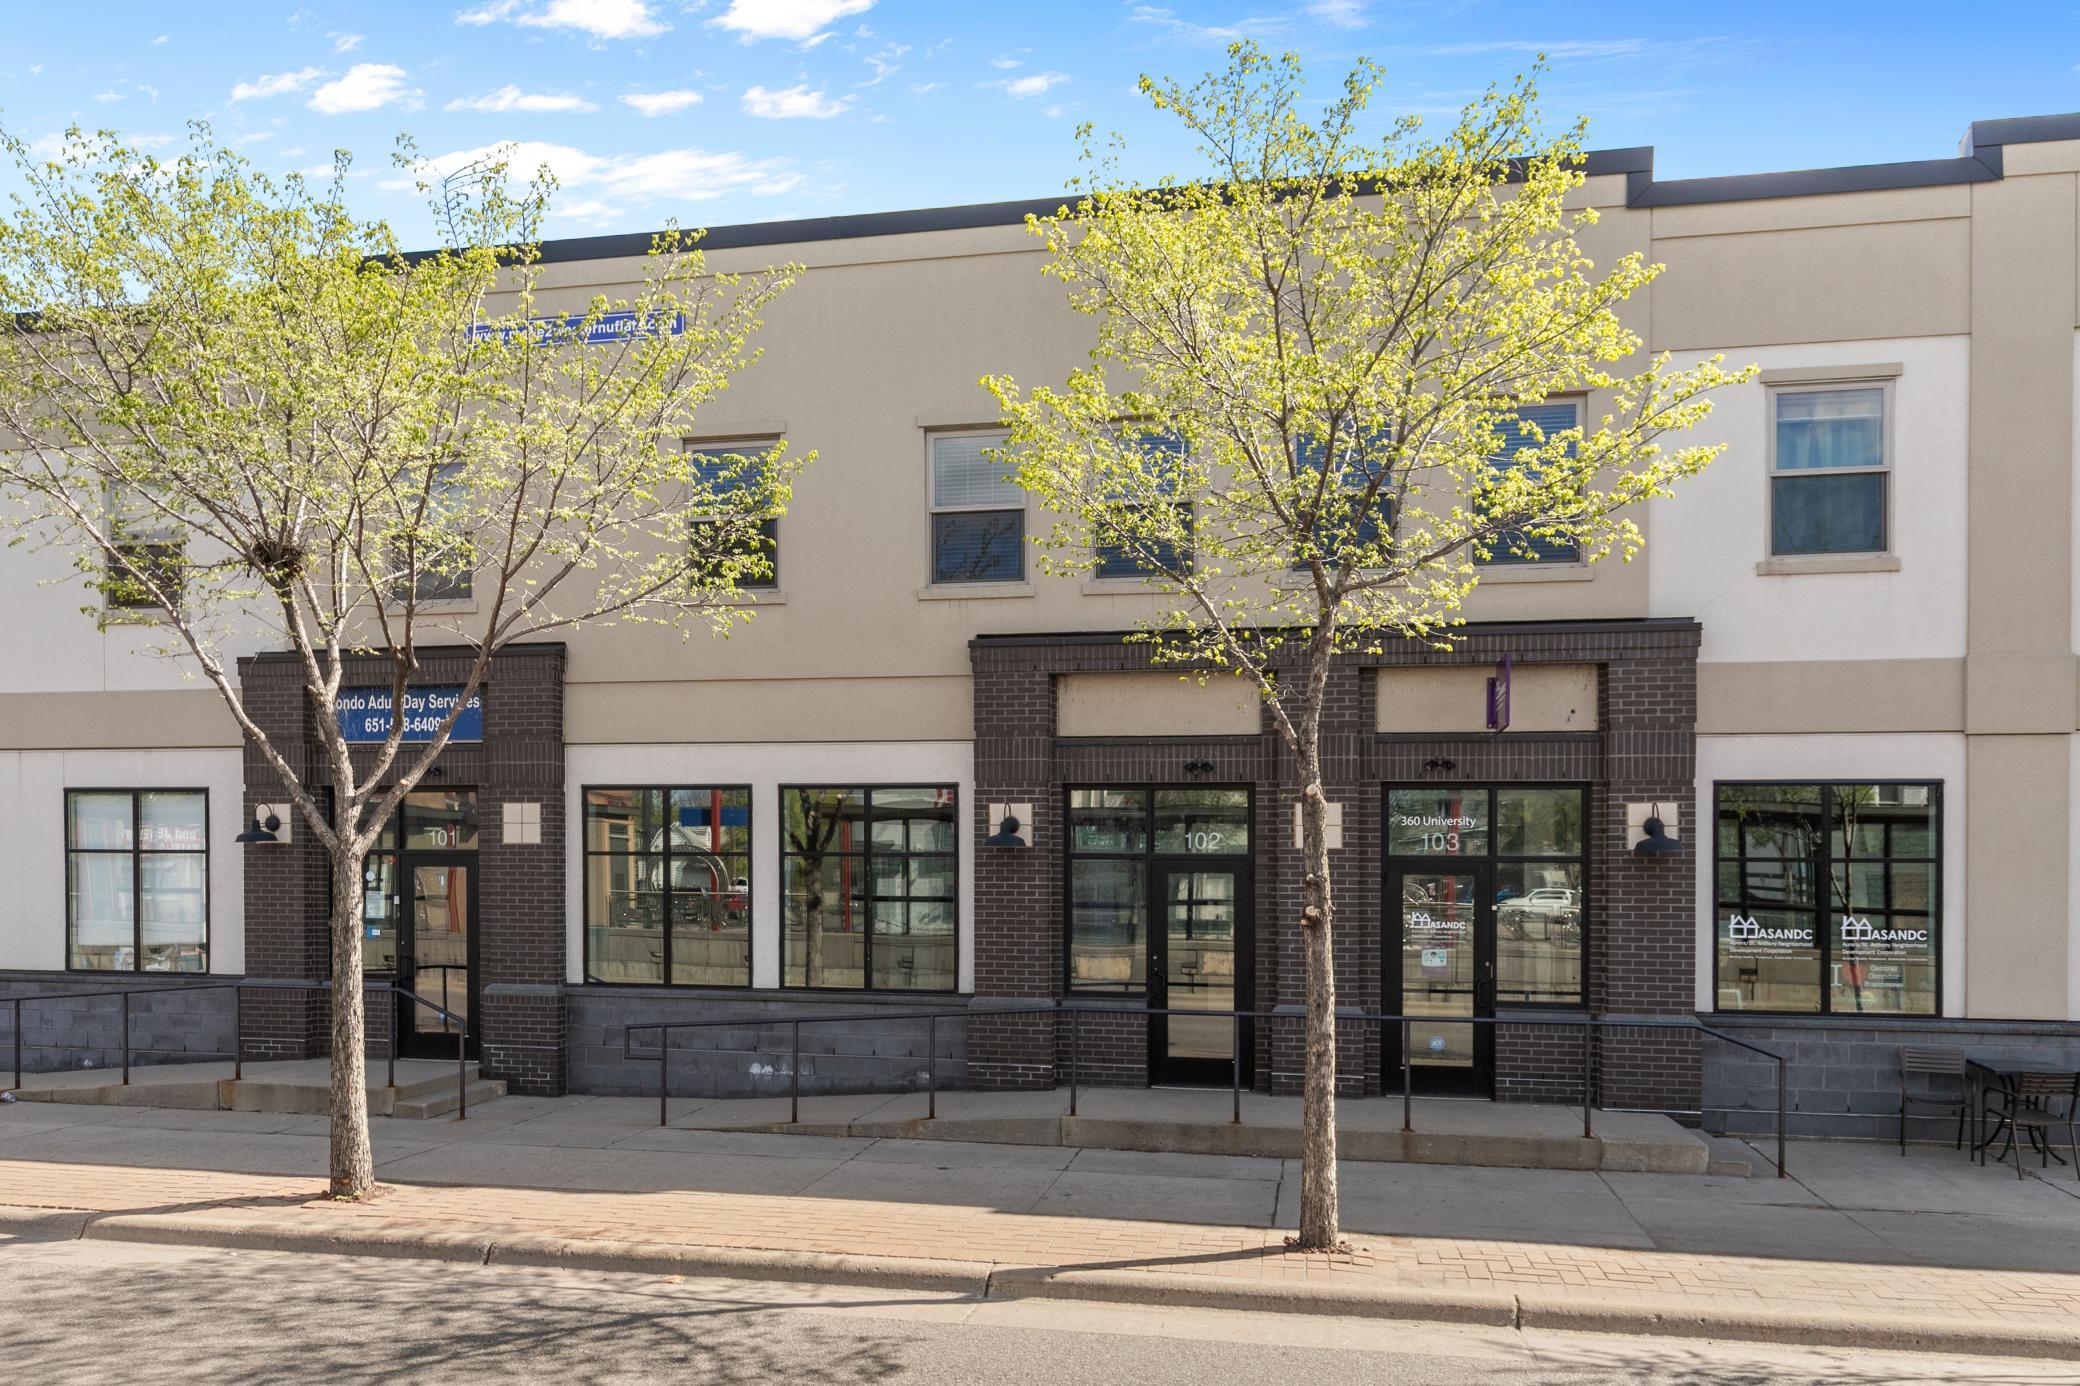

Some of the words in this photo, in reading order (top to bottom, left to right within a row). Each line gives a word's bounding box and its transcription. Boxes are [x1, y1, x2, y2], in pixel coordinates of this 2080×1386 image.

[334, 696, 366, 710] ondo
[368, 695, 400, 710] Adu
[404, 694, 425, 712] Day
[428, 694, 480, 708] Servies
[1401, 816, 1420, 826] 360
[1423, 816, 1476, 828] University
[429, 830, 455, 846] 101
[1185, 832, 1220, 849] 102
[1420, 832, 1460, 851] 103
[1430, 921, 1466, 929] ASANDC
[1758, 928, 1813, 940] ASANDC
[1871, 929, 1928, 941] ASANDC
